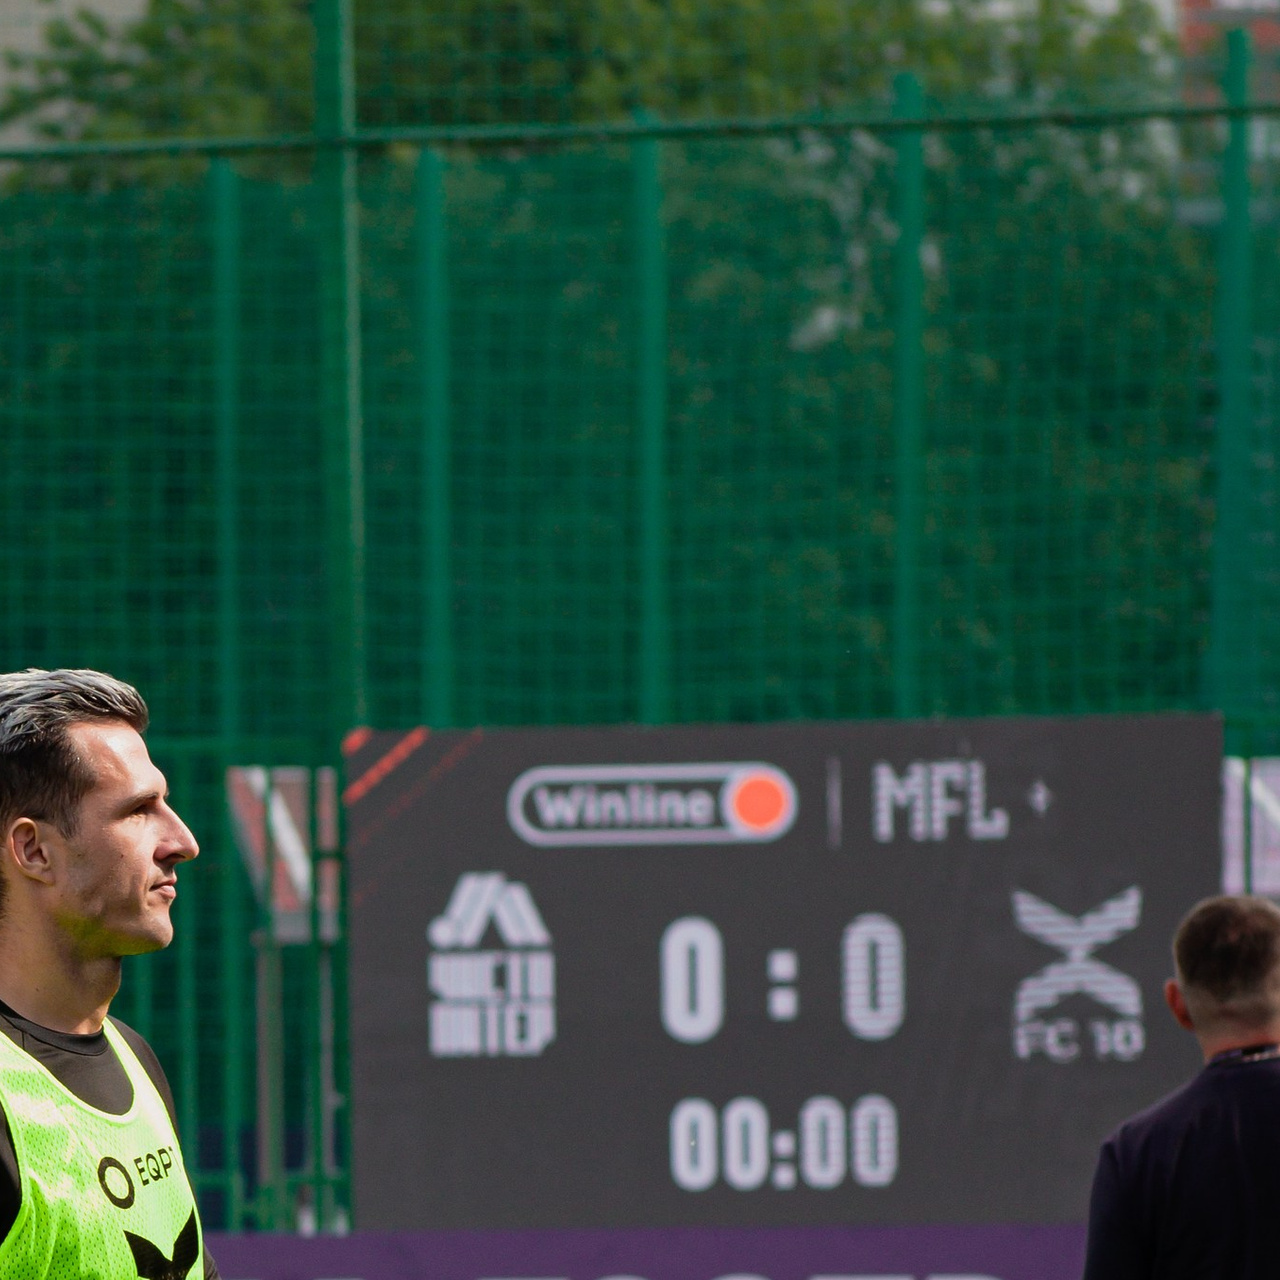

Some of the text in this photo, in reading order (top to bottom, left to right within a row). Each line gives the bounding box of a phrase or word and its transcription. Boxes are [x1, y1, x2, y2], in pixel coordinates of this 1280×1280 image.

[534, 782, 715, 827] Winline
[873, 760, 1010, 842] MFL
[661, 915, 724, 1043] 0
[842, 912, 906, 1041] 0
[1015, 1019, 1145, 1062] FC 10
[670, 1094, 898, 1191] 00:00
